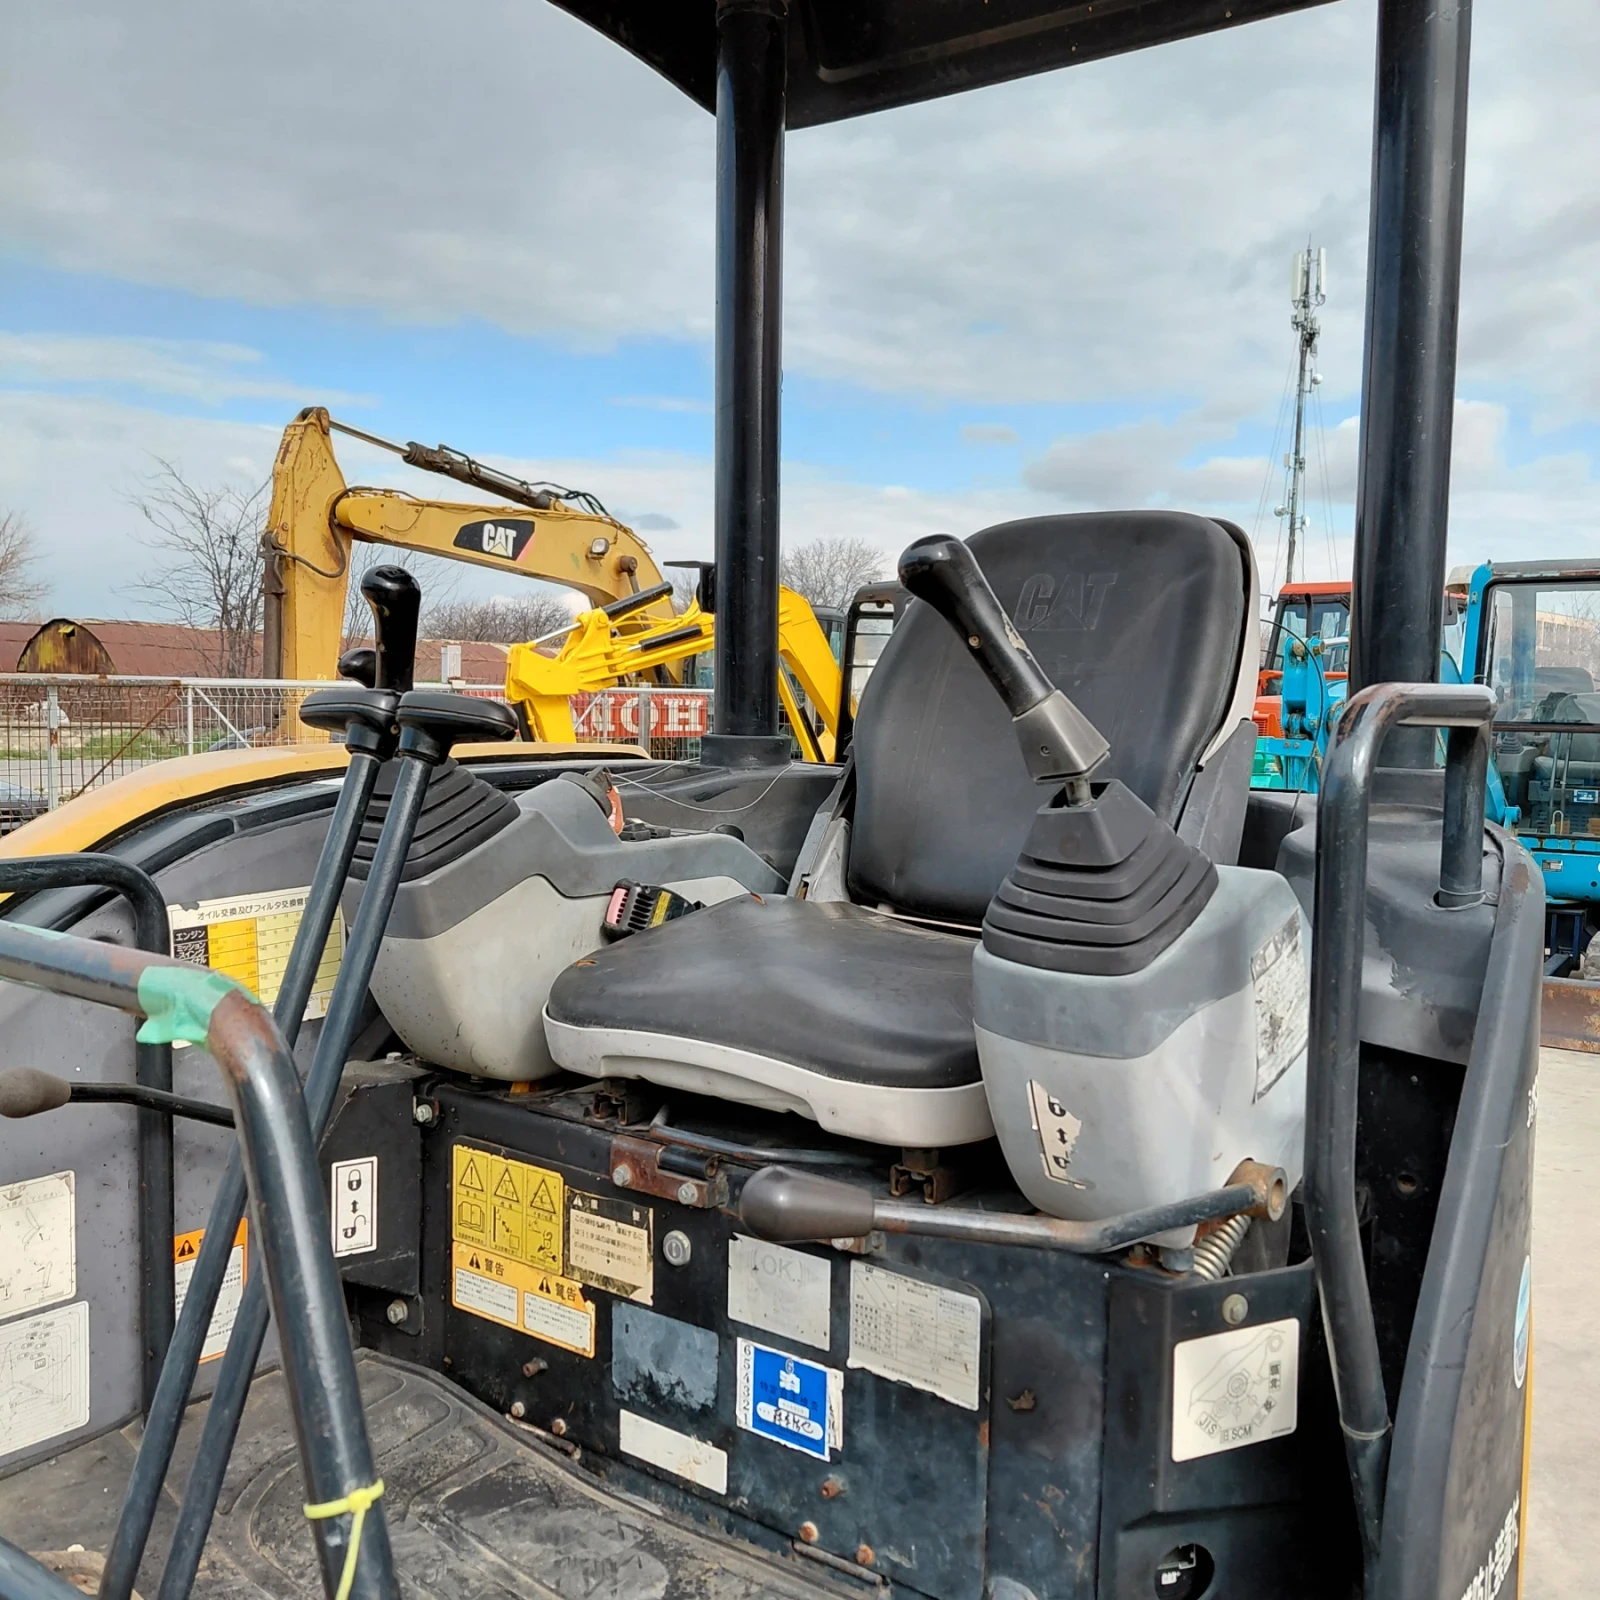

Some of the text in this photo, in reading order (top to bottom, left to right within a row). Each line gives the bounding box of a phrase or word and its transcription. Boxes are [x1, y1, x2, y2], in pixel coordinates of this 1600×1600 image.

[482, 522, 517, 558] CAT
[1013, 572, 1119, 631] CAT
[175, 930, 206, 941] エンジン
[485, 1257, 504, 1276] 警告
[555, 1282, 577, 1303] 警告
[1199, 1415, 1218, 1435] JIS
